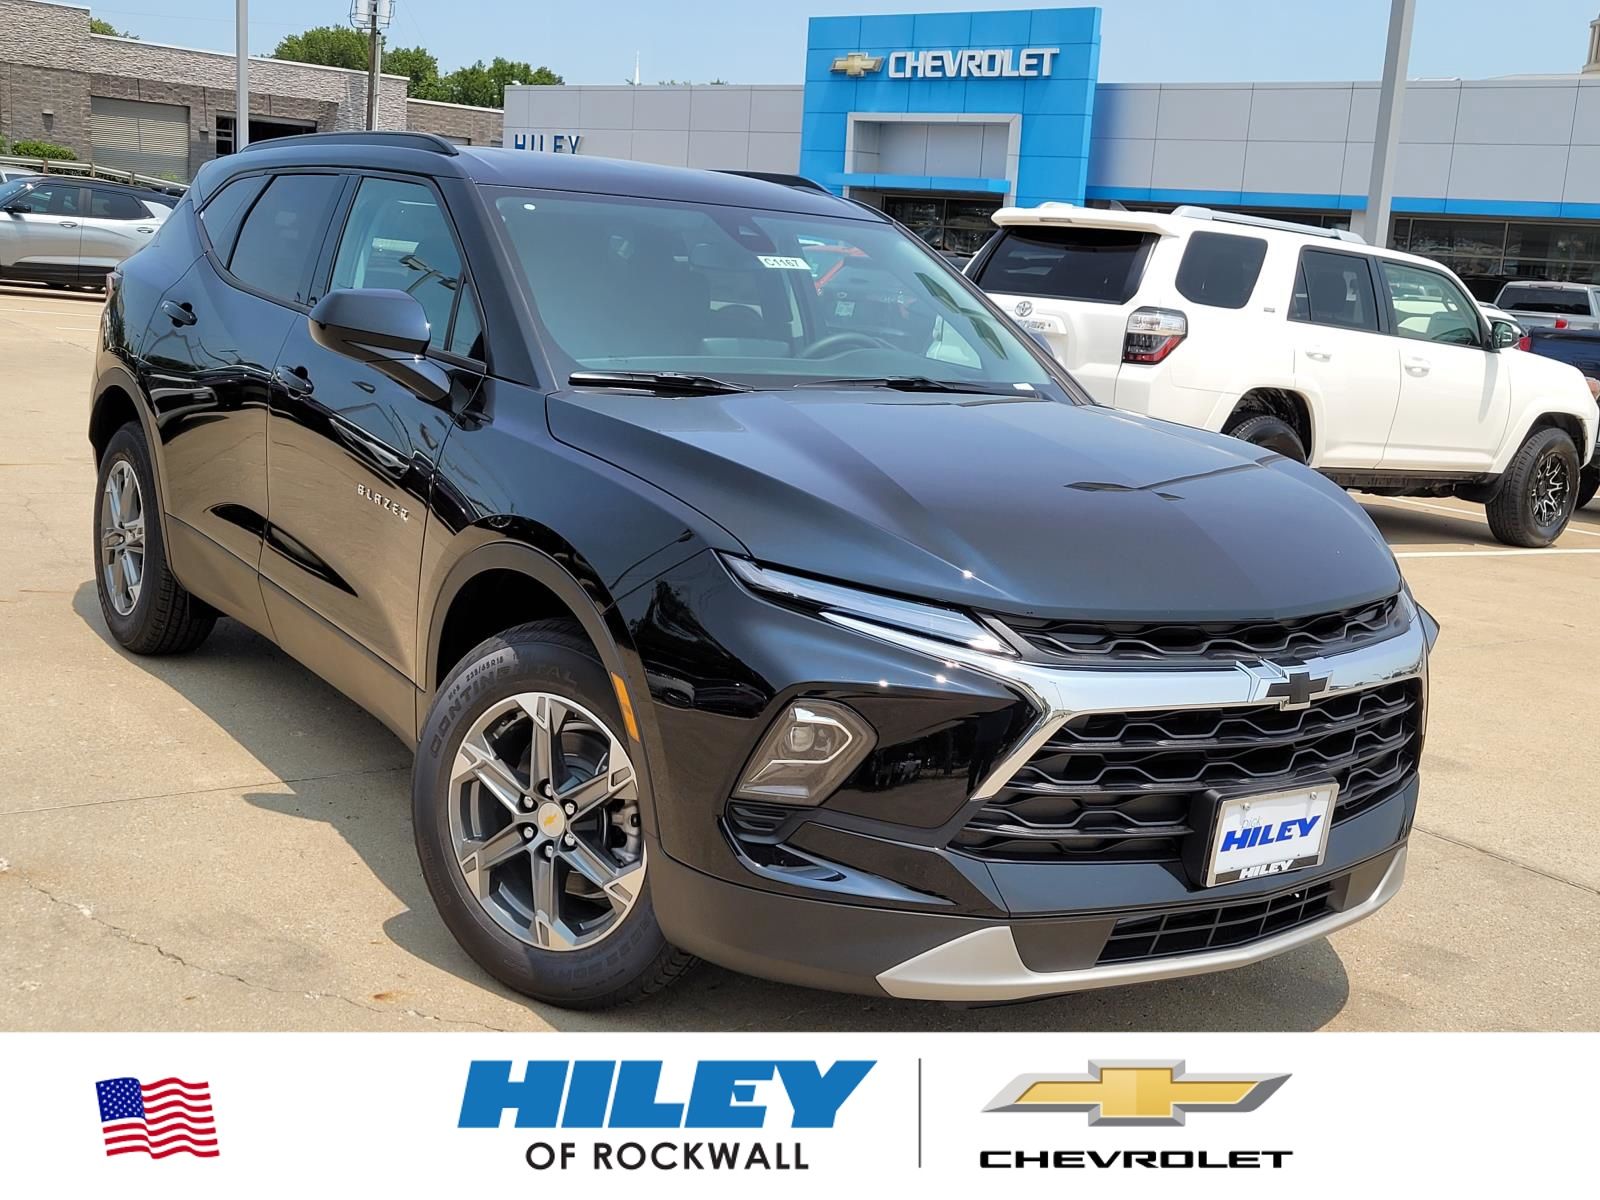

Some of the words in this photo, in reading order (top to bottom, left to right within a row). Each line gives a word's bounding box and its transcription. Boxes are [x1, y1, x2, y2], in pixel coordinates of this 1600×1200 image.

[889, 48, 1060, 79] CHEVROLET
[764, 258, 799, 267] C1167
[357, 483, 409, 521] BLAZER
[1220, 815, 1322, 852] HILEY
[1239, 859, 1294, 879] HILEY
